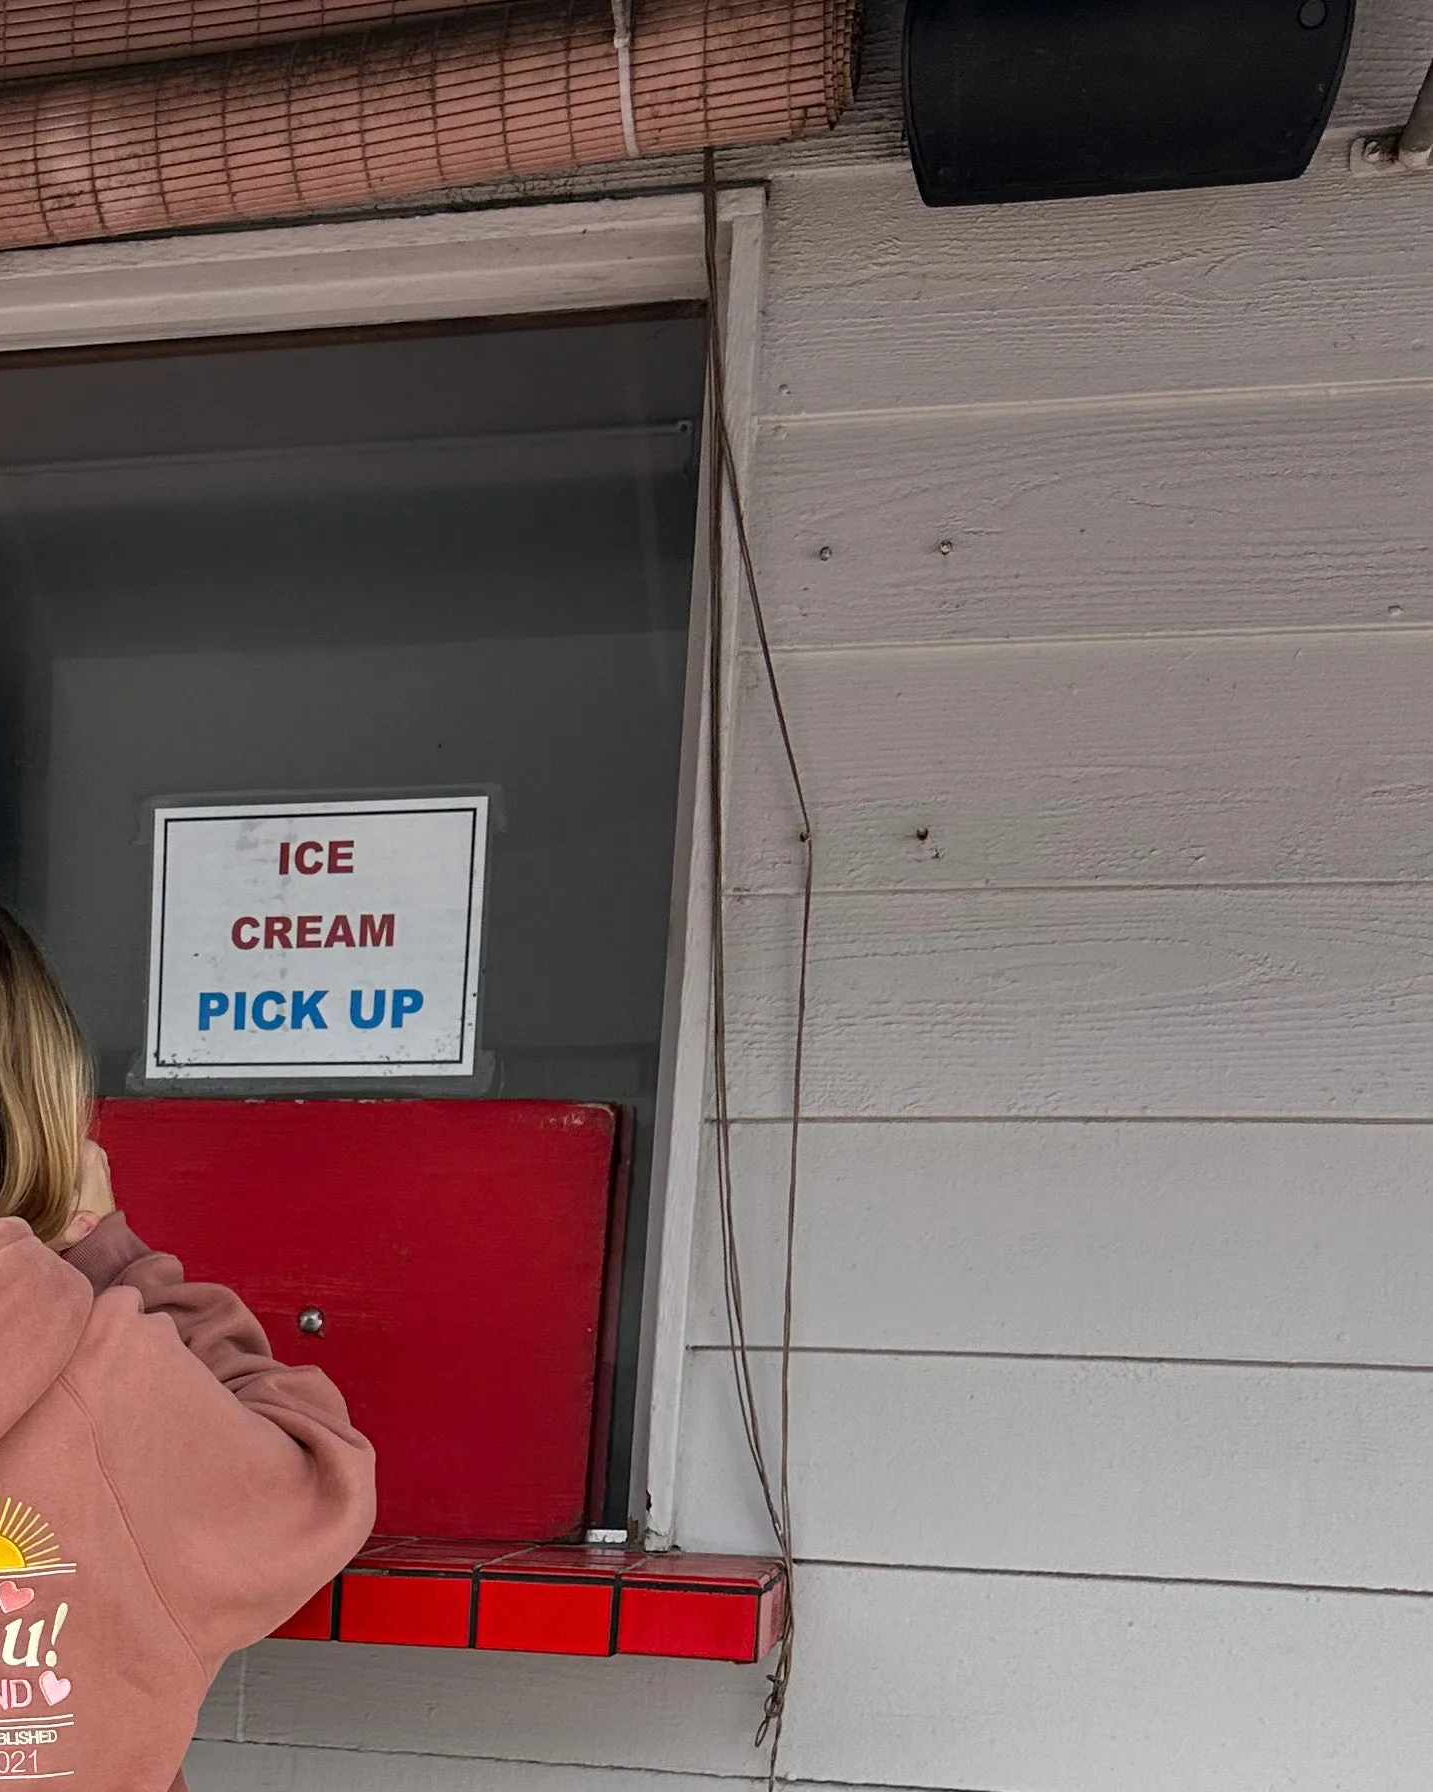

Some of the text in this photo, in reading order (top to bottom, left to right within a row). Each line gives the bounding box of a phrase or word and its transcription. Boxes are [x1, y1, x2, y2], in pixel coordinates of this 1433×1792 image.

[278, 840, 355, 876] ICE
[231, 913, 395, 950] CREAM
[198, 988, 425, 1031] PICK UP
